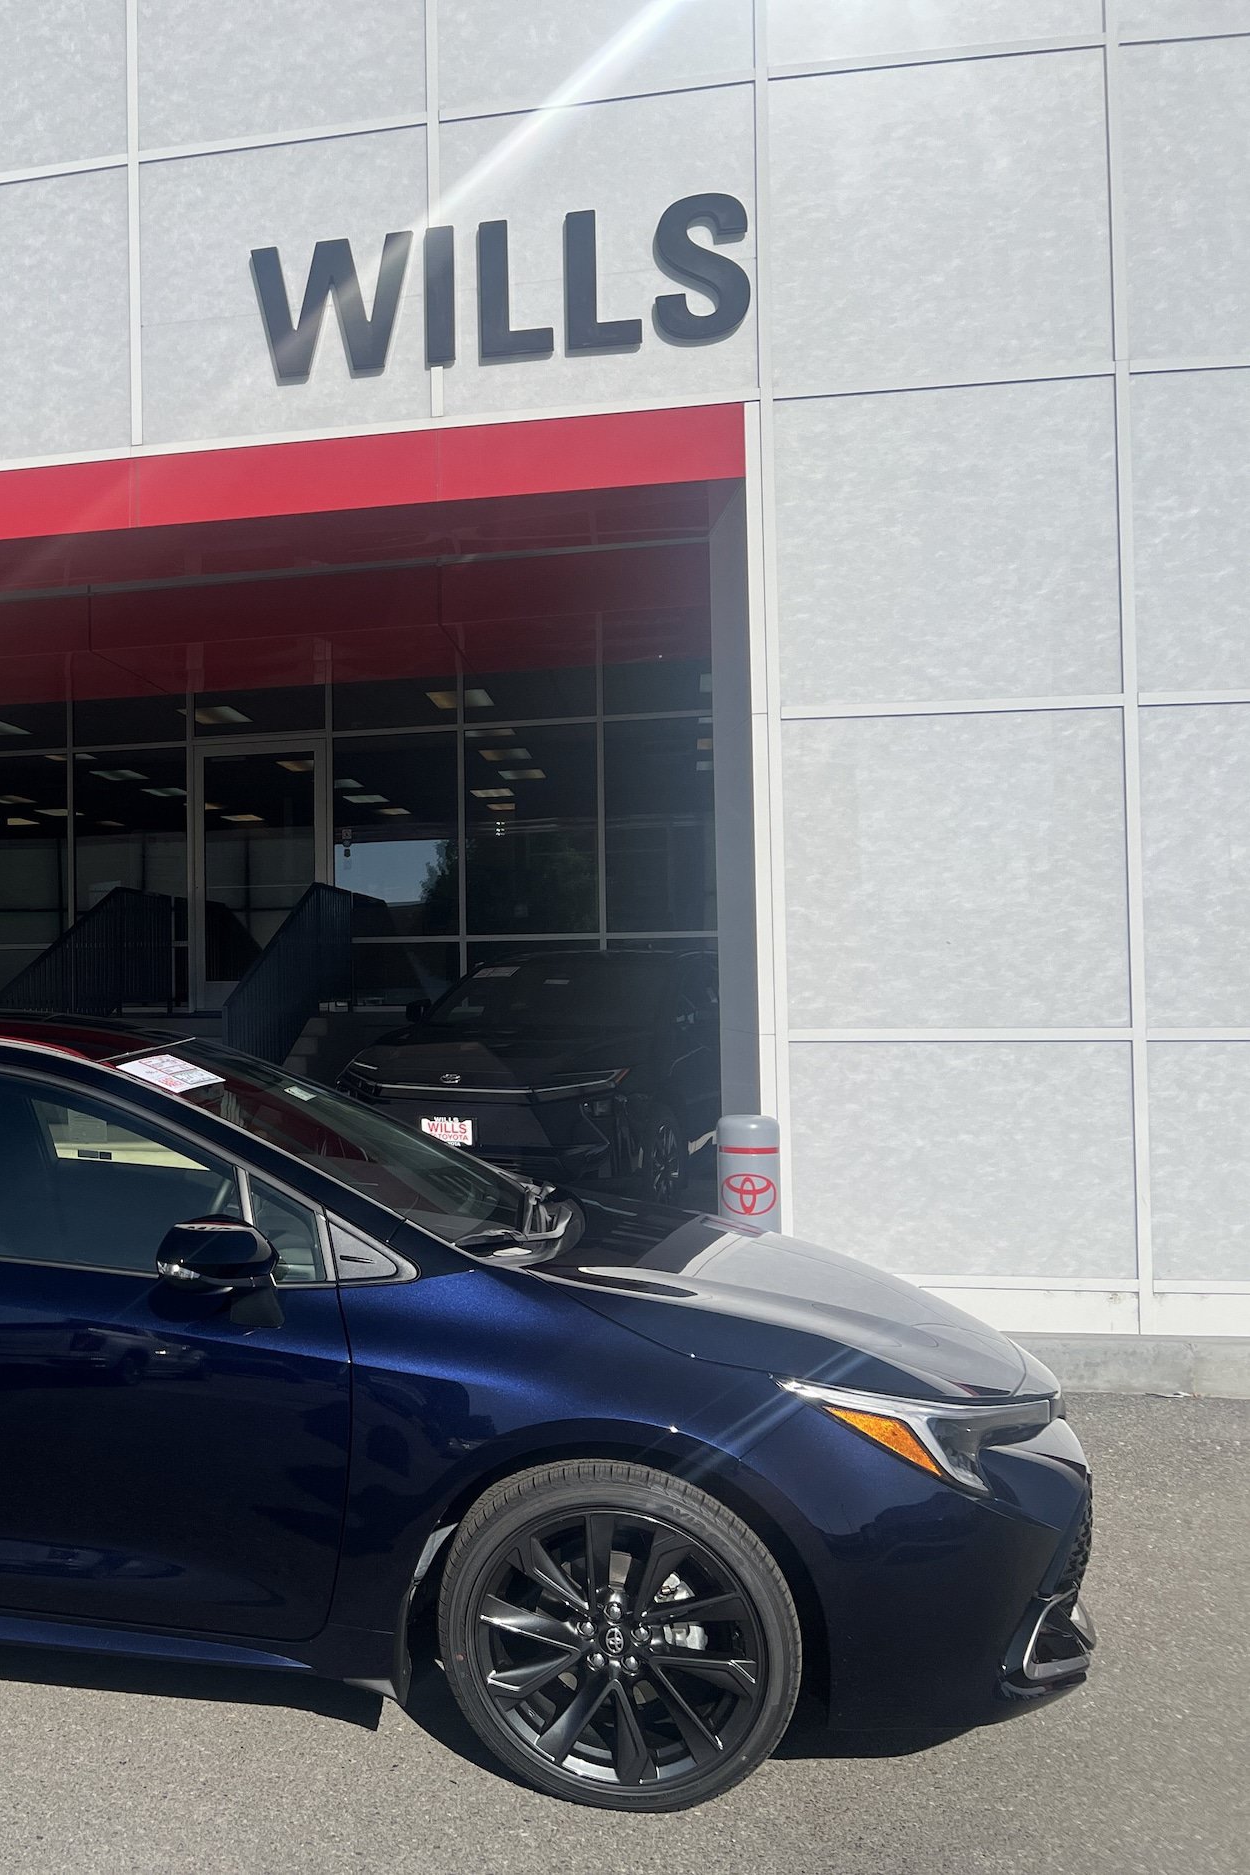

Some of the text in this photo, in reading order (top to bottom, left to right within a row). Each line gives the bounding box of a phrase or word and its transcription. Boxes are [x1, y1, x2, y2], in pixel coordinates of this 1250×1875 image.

[250, 192, 751, 382] WILLS
[427, 1122, 467, 1134] WILLS
[438, 1133, 469, 1141] TOYOTA
